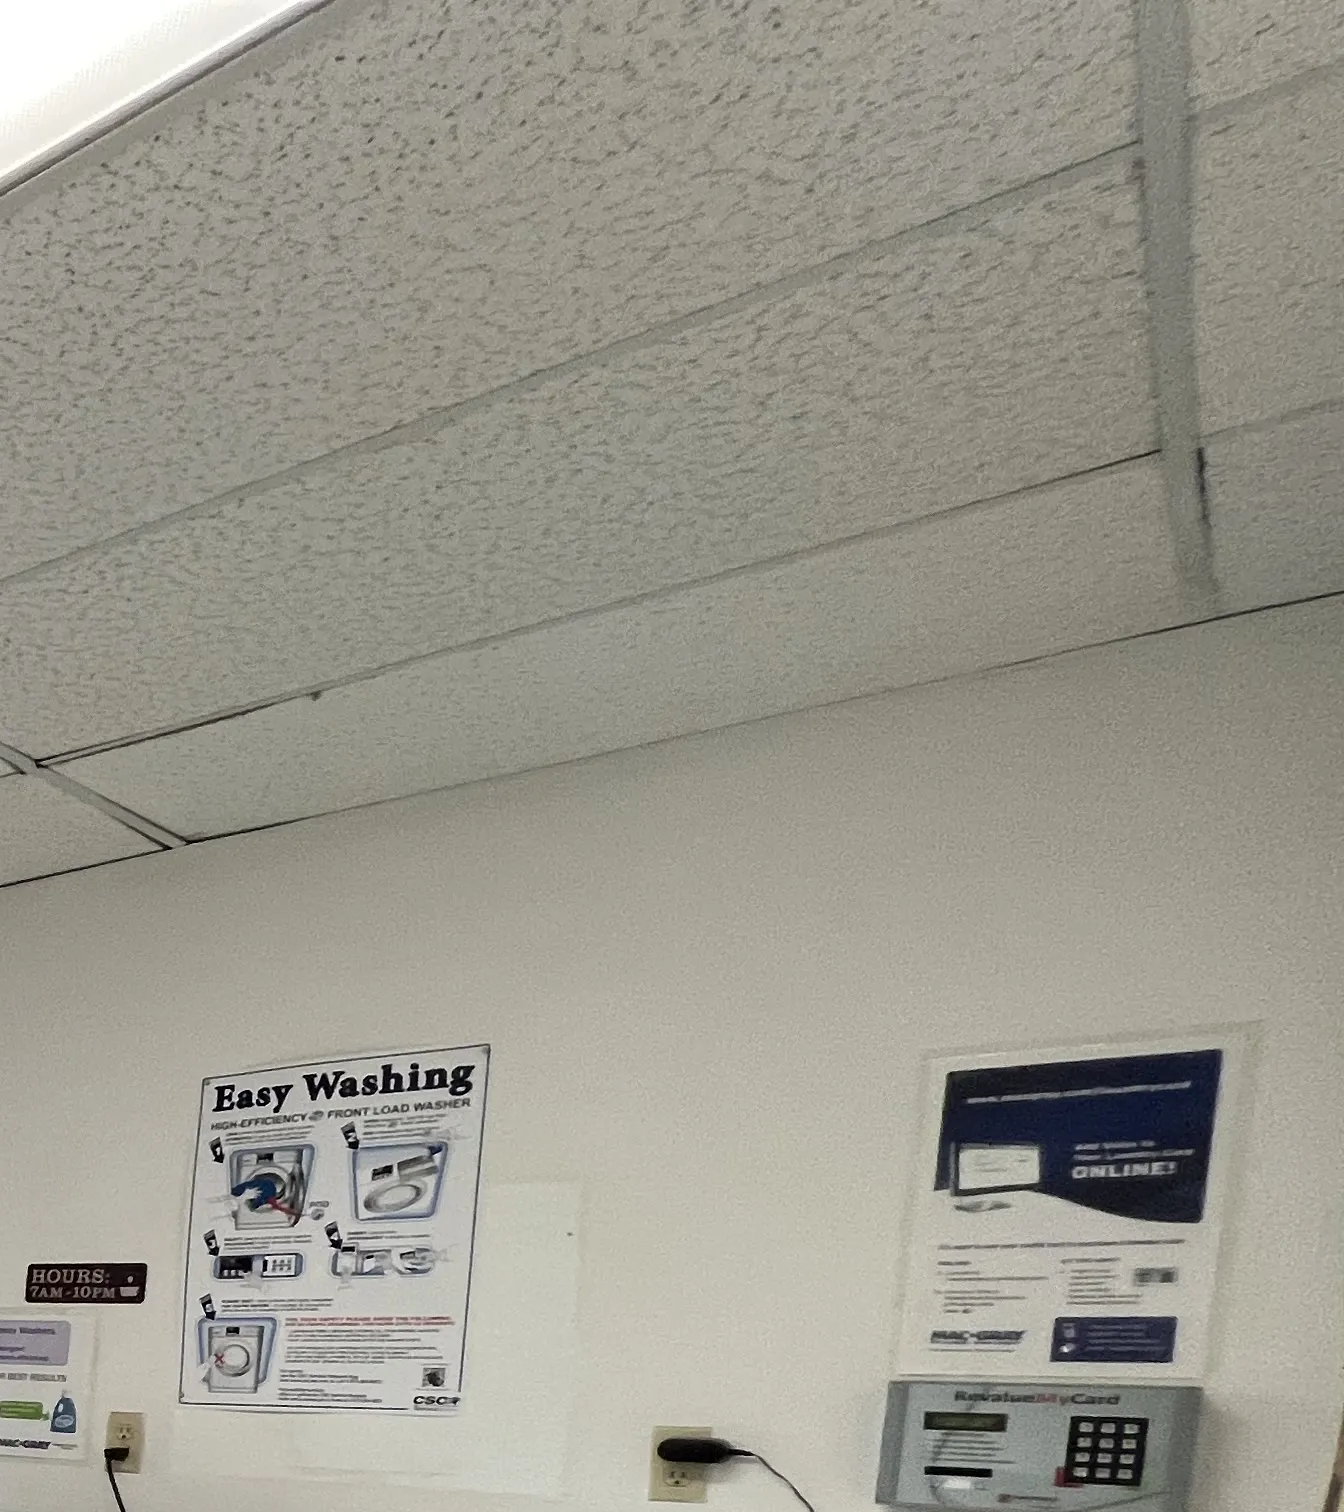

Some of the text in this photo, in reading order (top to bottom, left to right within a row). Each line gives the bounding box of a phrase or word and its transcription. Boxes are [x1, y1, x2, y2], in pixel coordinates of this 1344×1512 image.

[212, 1063, 475, 1113] Easy Washing
[327, 1107, 369, 1119] FRONT
[373, 1103, 410, 1115] LOAD
[413, 1098, 471, 1111] WASHER
[32, 1268, 110, 1284] HOURS:
